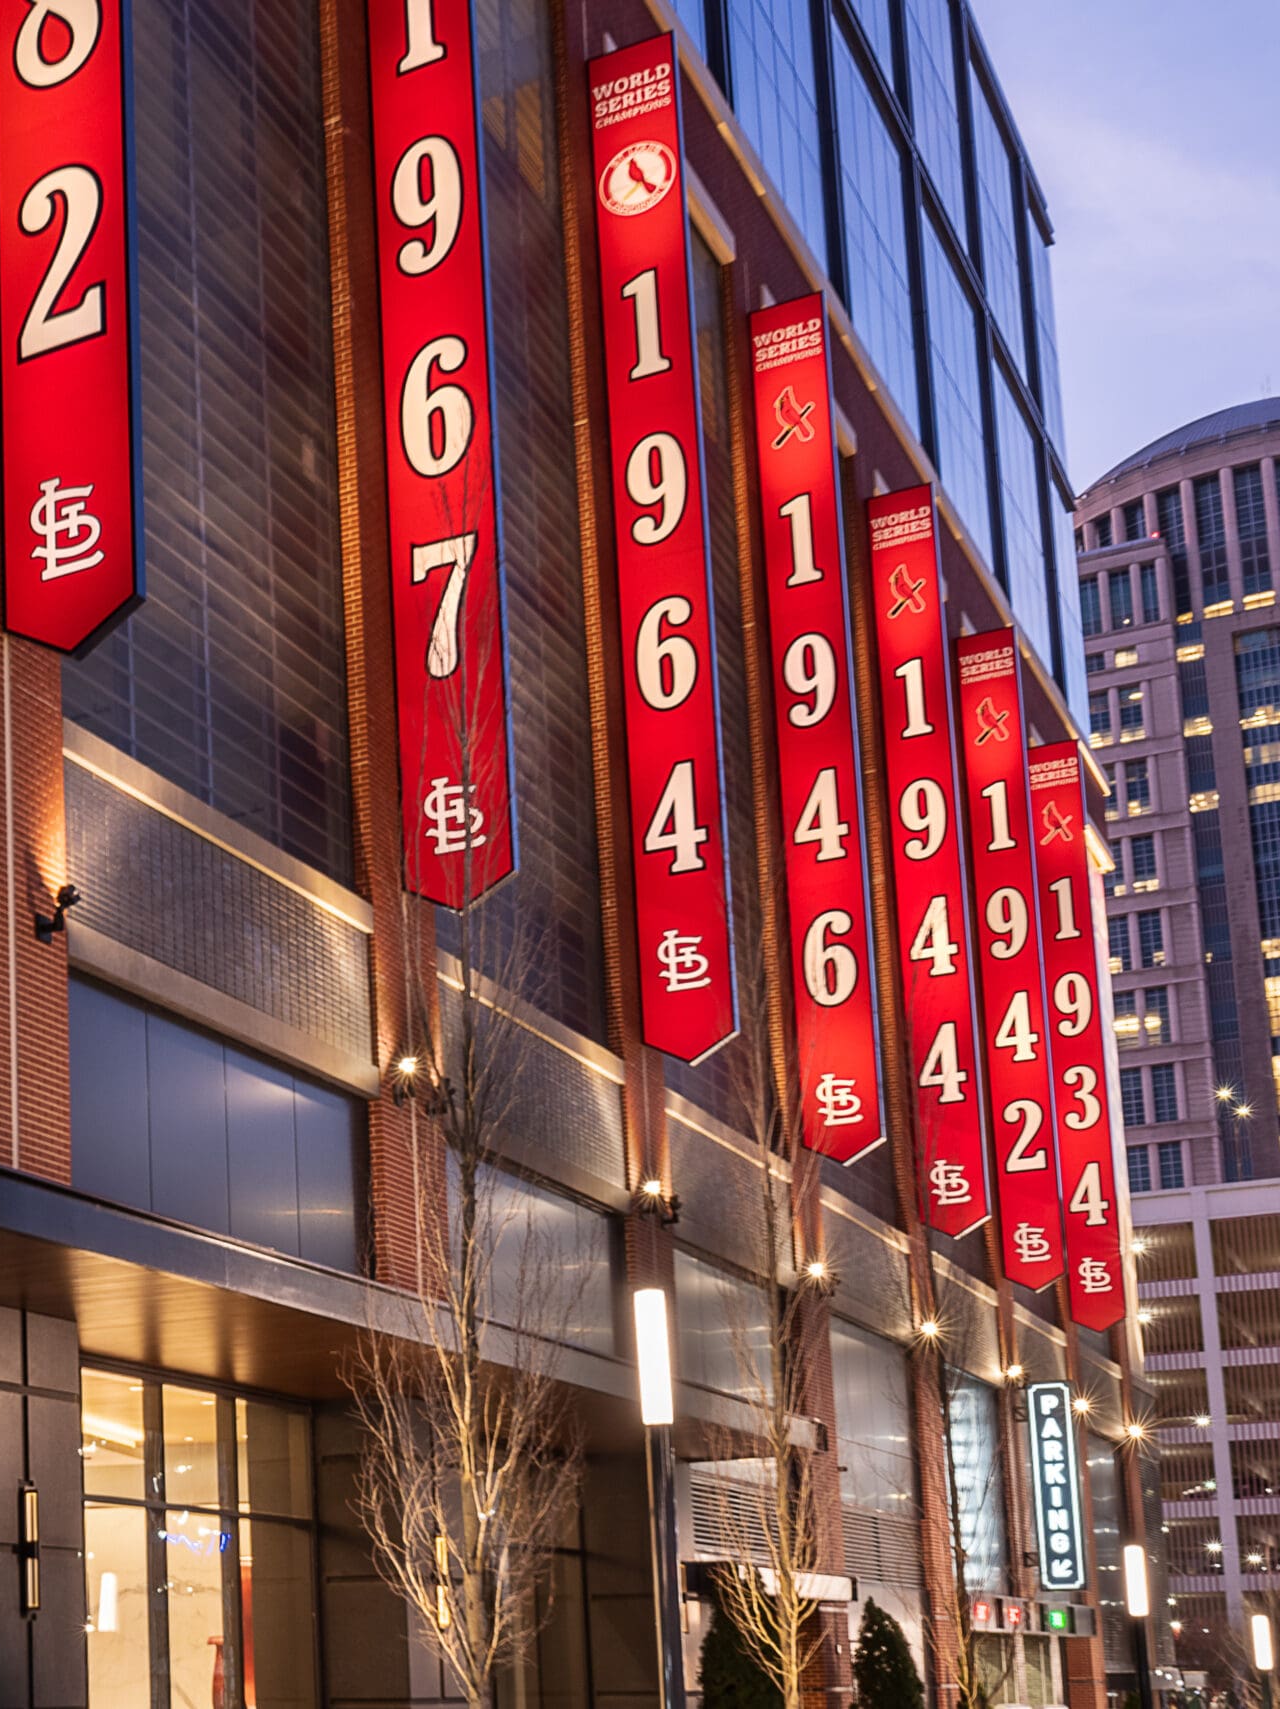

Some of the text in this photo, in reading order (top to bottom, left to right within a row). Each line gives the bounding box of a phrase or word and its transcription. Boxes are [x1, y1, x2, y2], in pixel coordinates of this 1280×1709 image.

[592, 63, 670, 101] WORLD
[595, 79, 671, 118] SERIES
[595, 95, 672, 129] CHAMPIONS
[753, 318, 821, 348] WORLD
[755, 331, 822, 362] SERIES
[870, 506, 931, 529] WORLD
[872, 518, 932, 542] SERIES
[621, 267, 708, 876] 1964
[959, 646, 1013, 666] WORLD
[960, 657, 1014, 678] SERIES
[779, 493, 858, 1007] 1946
[1029, 757, 1078, 774] WORLD
[1030, 767, 1078, 783] SERIES
[894, 657, 967, 1104] 1944
[981, 780, 1047, 1173] 1942
[1048, 876, 1110, 1227] 1934
[1039, 1394, 1071, 1554] PARKING
